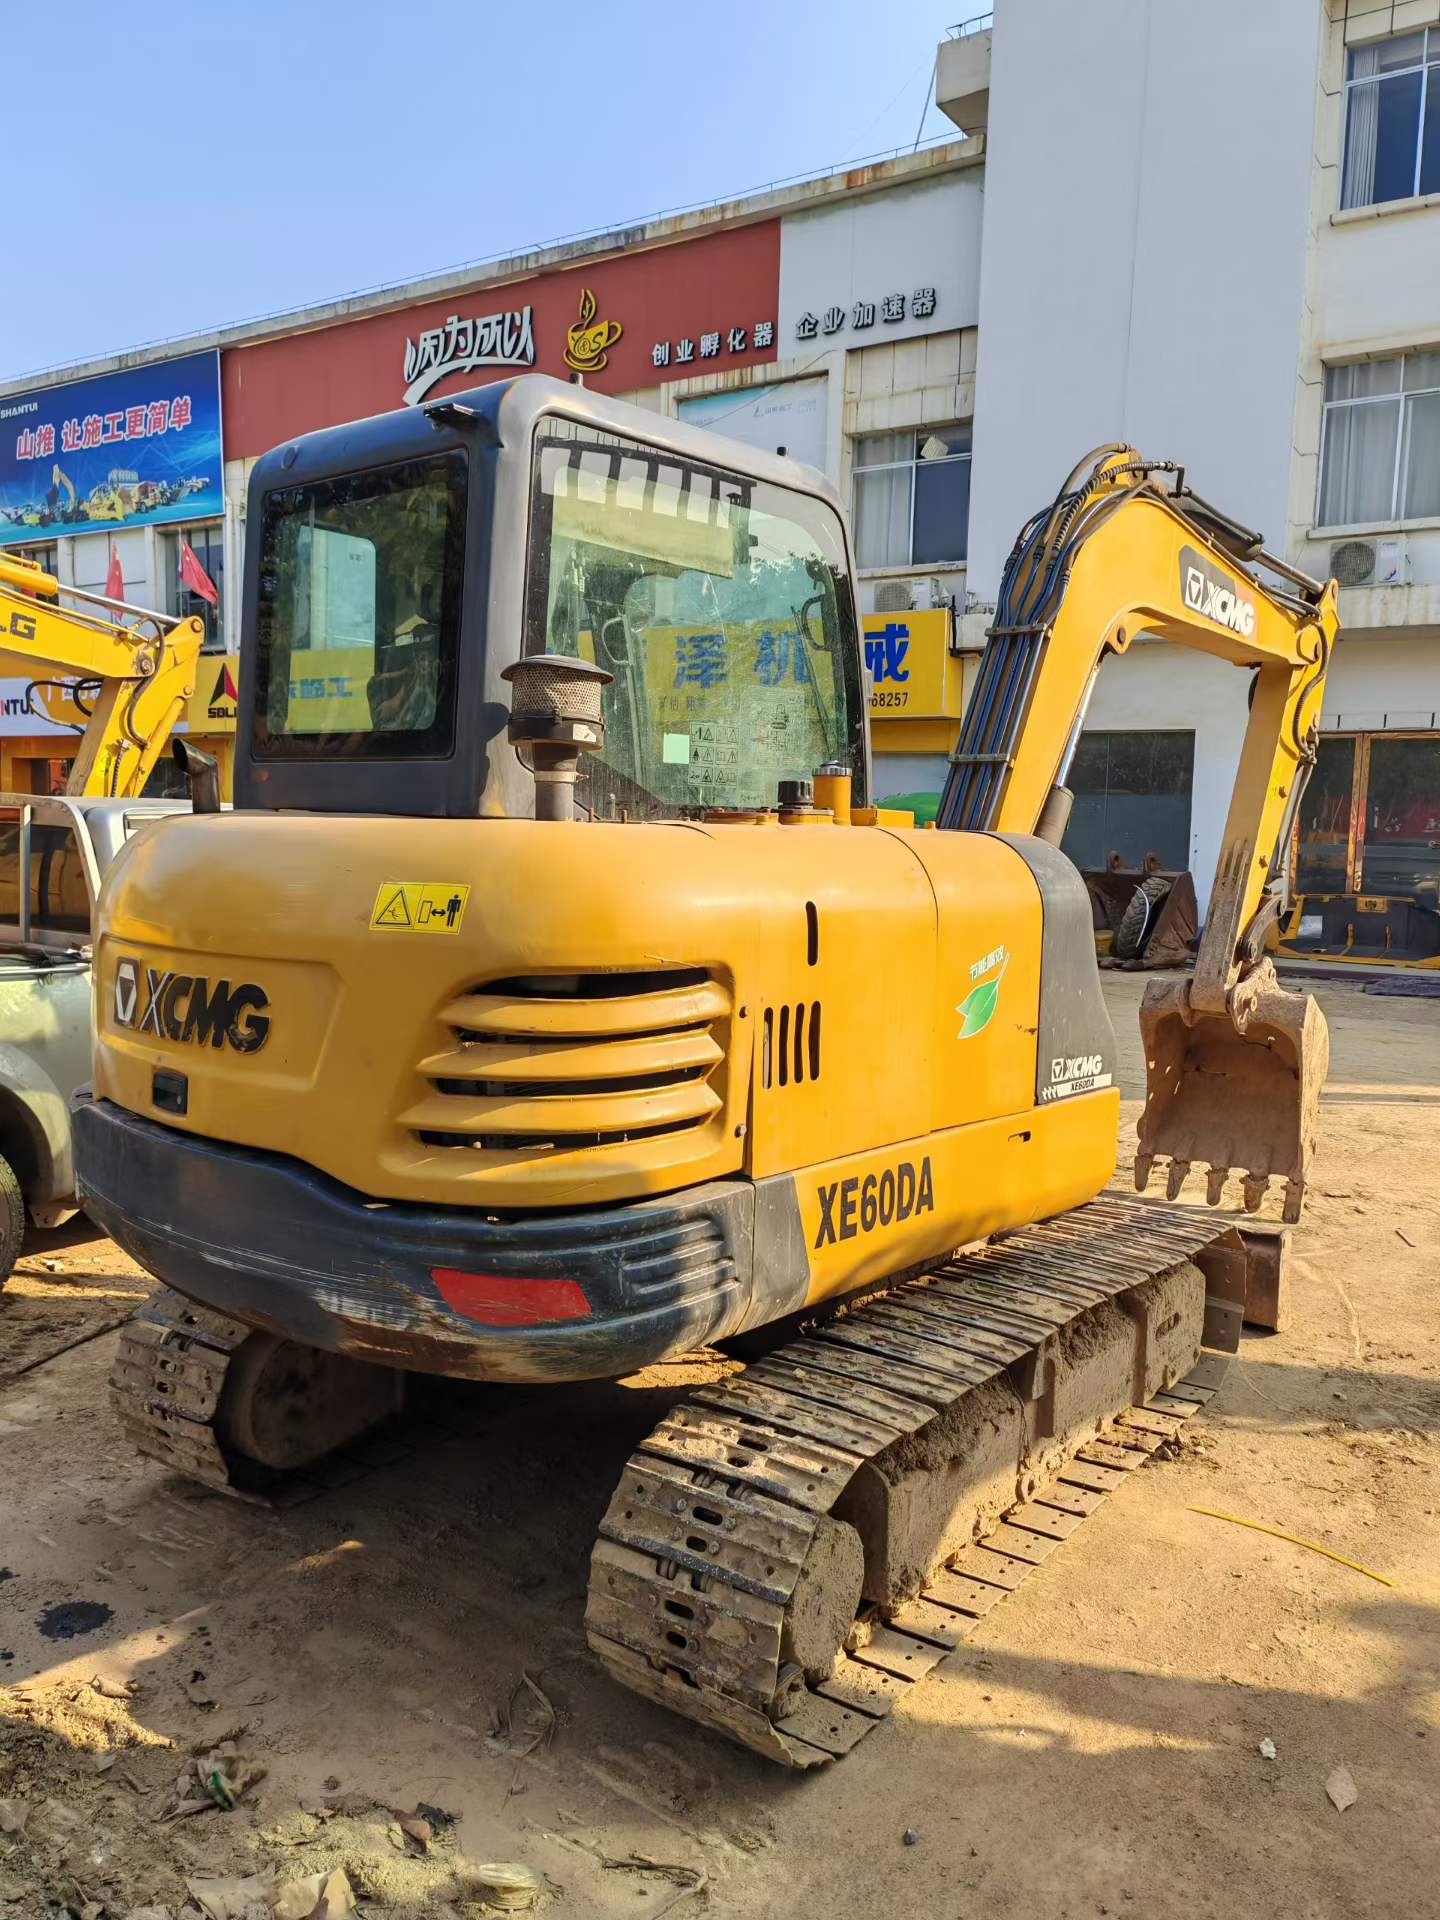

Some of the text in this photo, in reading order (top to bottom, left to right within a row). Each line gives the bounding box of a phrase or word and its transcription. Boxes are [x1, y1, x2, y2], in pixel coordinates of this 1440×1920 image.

[795, 287, 937, 340] 企业加速器
[652, 321, 774, 366] 创业孵化器
[0, 402, 38, 419] SHANTUI
[16, 396, 192, 460] 山推 让施工更简单
[1201, 580, 1255, 637] XCMG
[139, 967, 272, 1055] XCMG
[1063, 1054, 1103, 1080] XCMG
[1071, 1078, 1095, 1092] XE60DA
[814, 1155, 934, 1250] XE60DA
